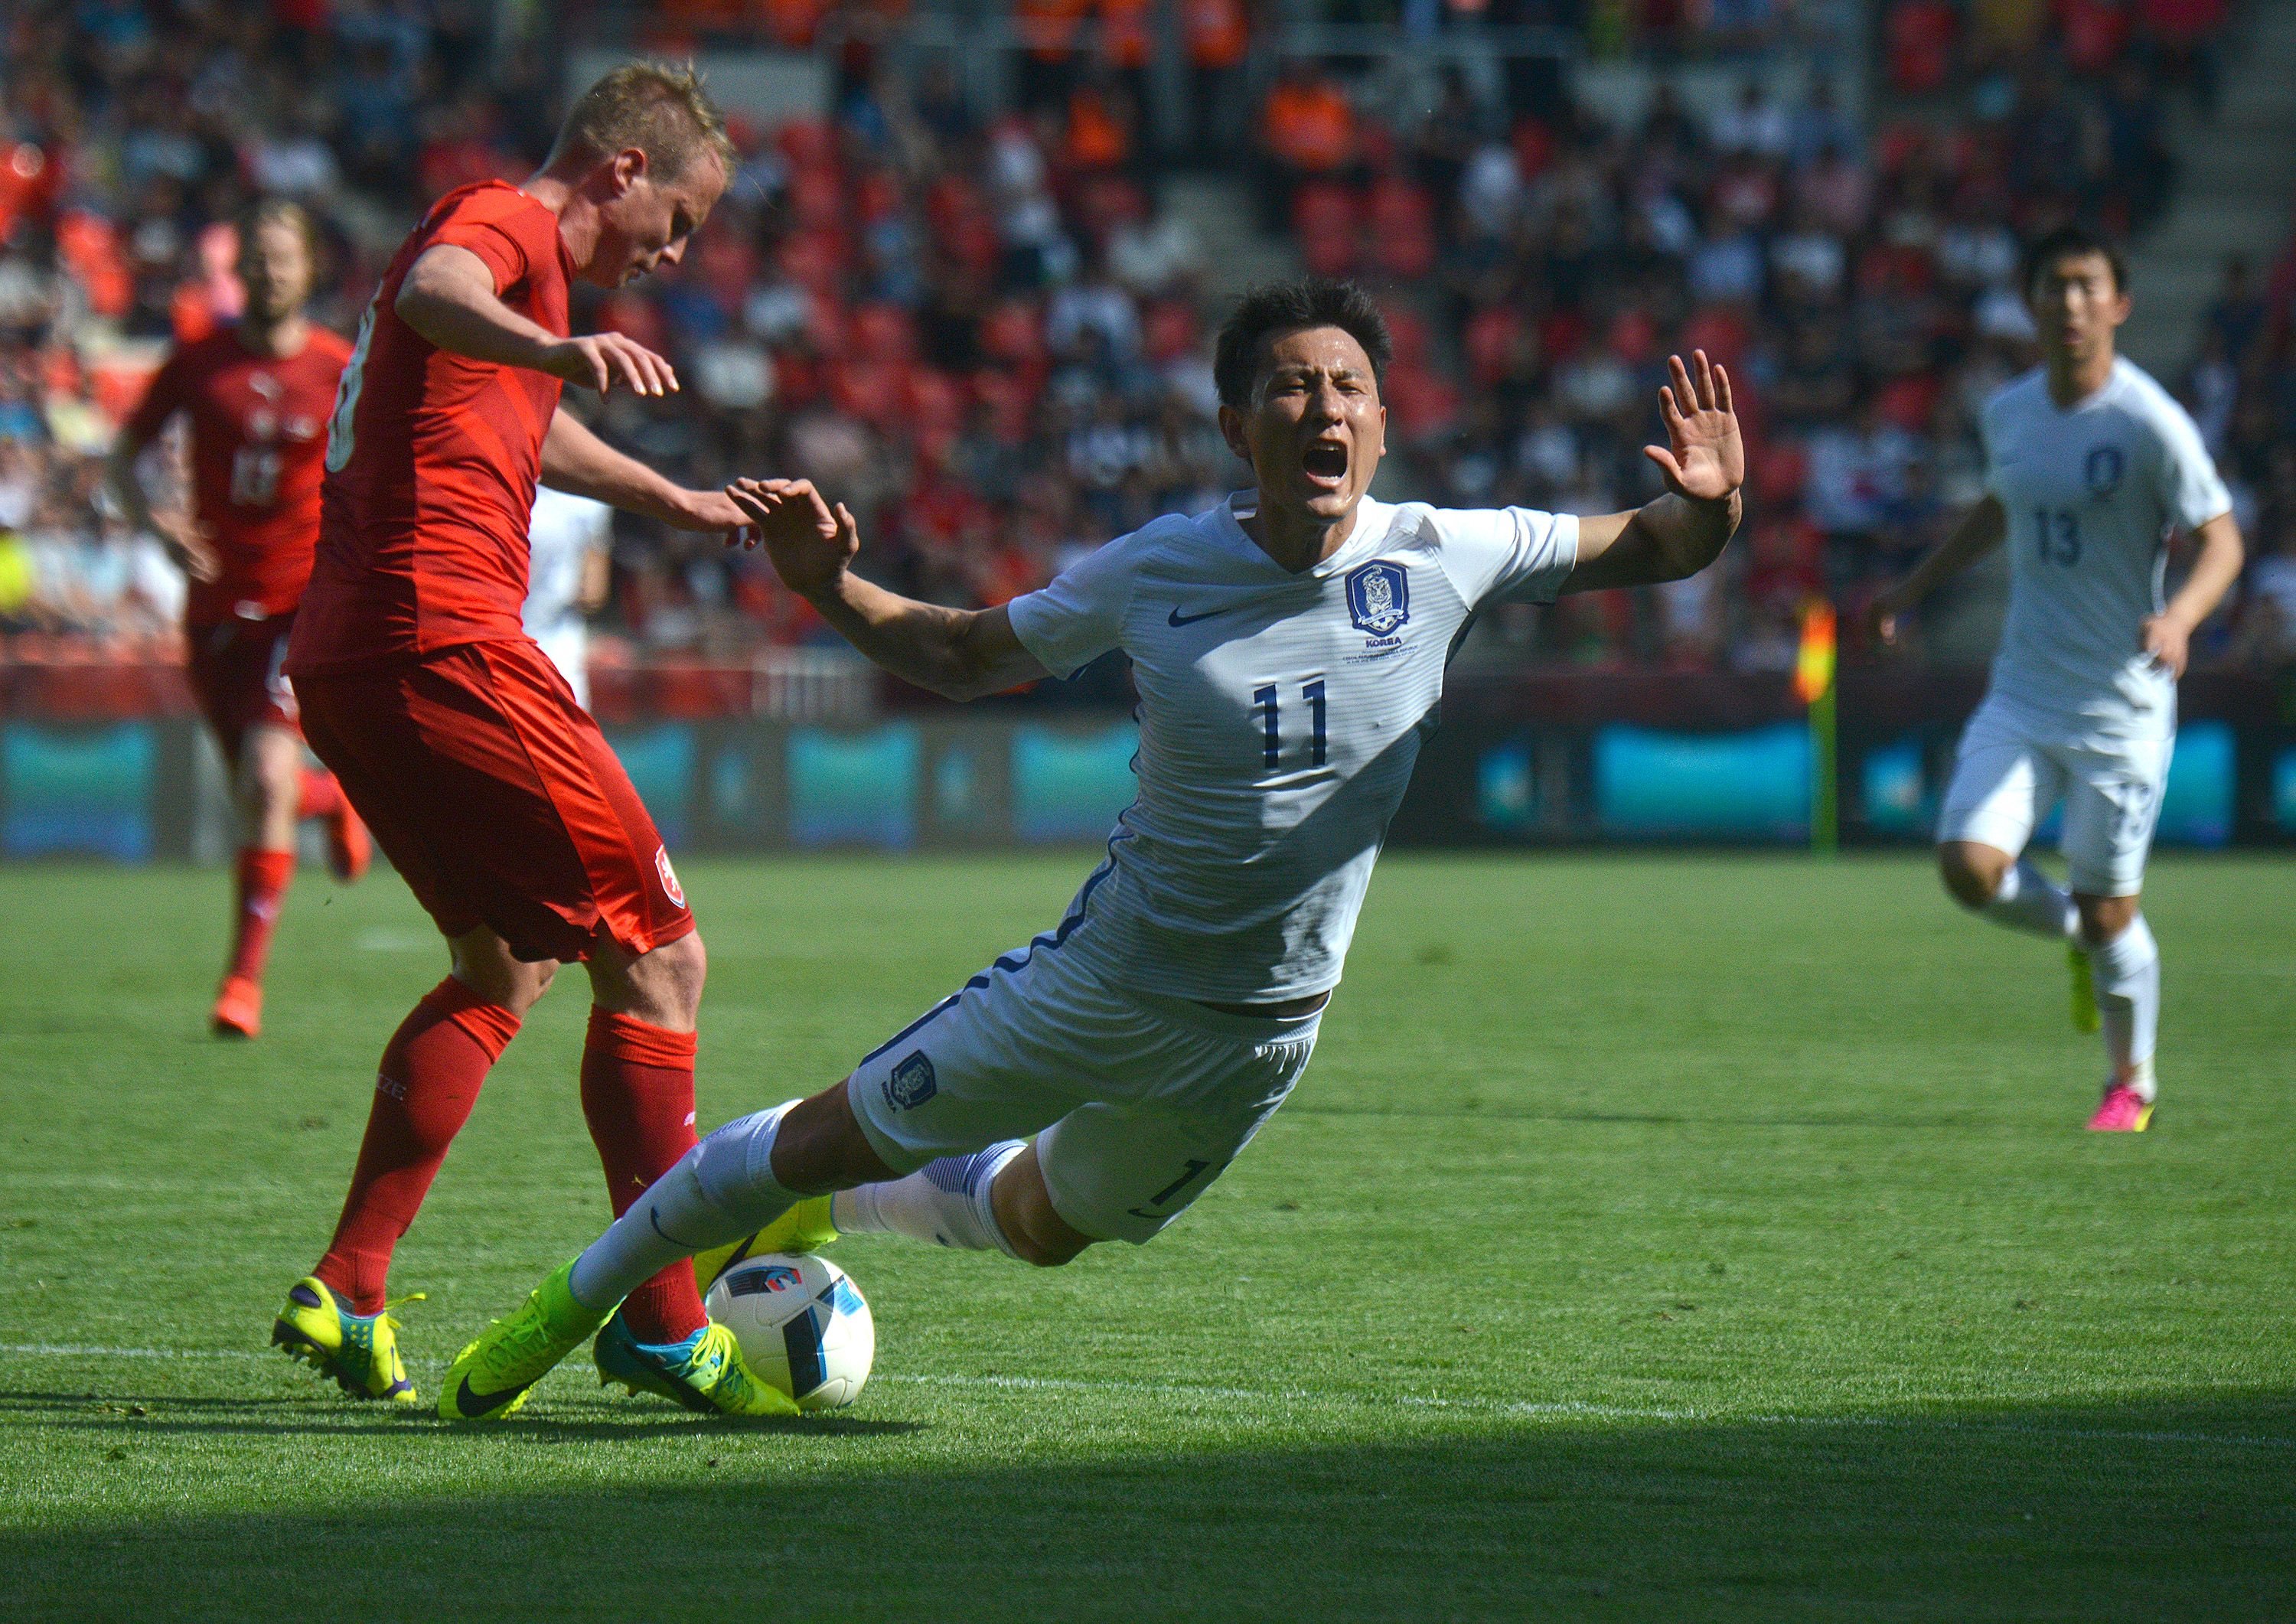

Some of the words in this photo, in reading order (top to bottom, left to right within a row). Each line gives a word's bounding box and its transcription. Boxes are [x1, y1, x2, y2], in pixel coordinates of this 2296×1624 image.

[2033, 507, 2081, 566] 13
[1365, 636, 1402, 648] KOREA
[1253, 680, 1326, 768] 11
[881, 1081, 897, 1114] KOREA
